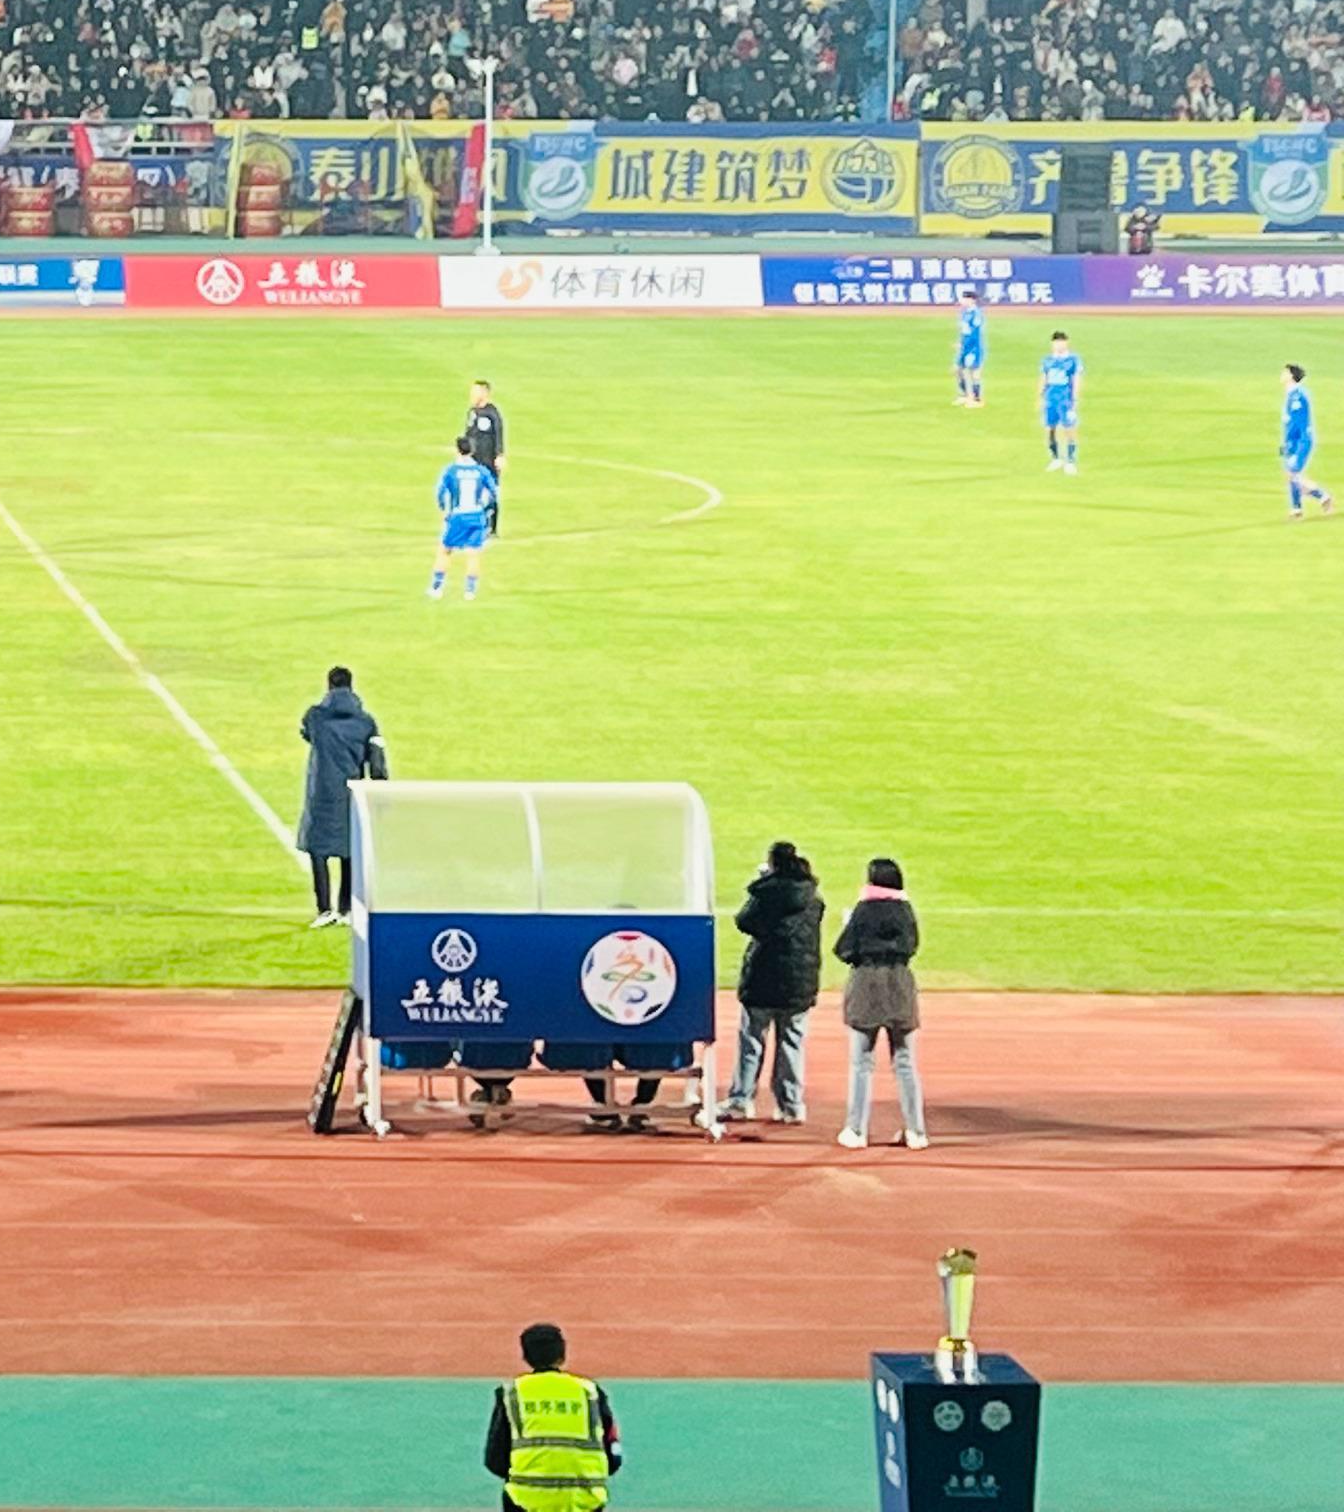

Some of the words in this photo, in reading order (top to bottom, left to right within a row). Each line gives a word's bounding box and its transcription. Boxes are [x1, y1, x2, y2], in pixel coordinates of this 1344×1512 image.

[608, 148, 811, 203] 城建筑梦
[550, 266, 706, 299] 体育休闲
[400, 977, 509, 1009] 五粮液
